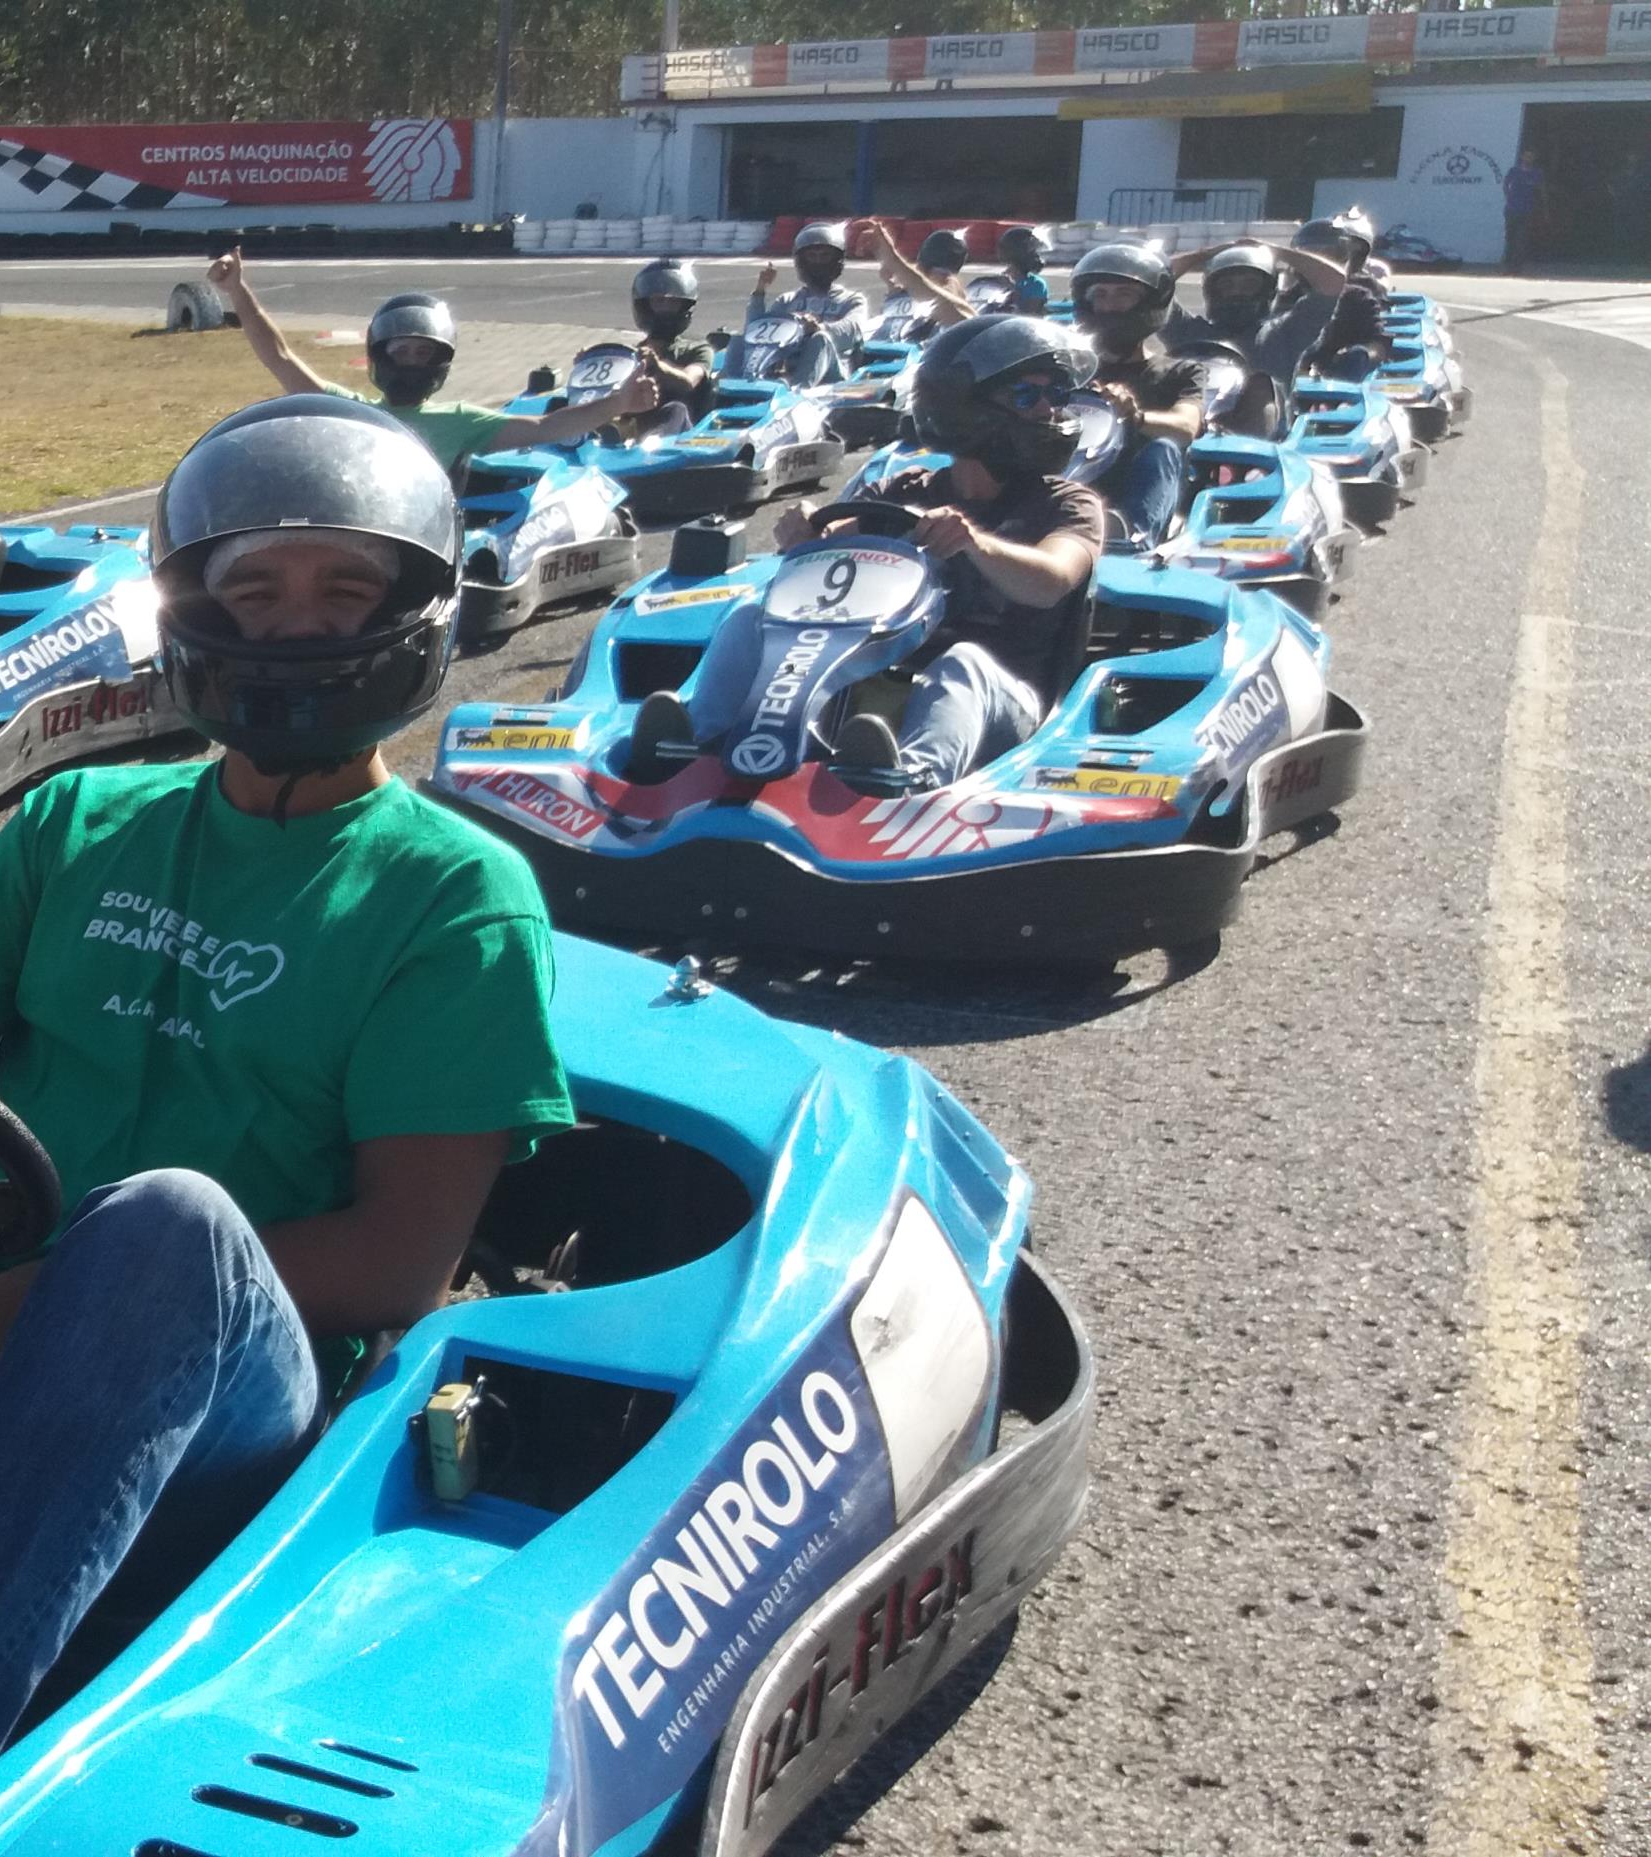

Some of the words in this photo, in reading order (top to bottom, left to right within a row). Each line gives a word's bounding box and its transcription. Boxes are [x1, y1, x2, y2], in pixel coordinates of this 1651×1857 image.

[1245, 24, 1330, 46] HASCO
[1424, 16, 1516, 38] HASCO
[932, 40, 1003, 59] HASCO
[1083, 33, 1160, 52] HASCO
[793, 46, 859, 66] HASCO
[141, 147, 225, 163] CENTROS
[230, 140, 353, 163] MAQUINAÇÃO
[185, 169, 232, 185] ALTA
[236, 167, 348, 183] VELOCIDADE
[754, 321, 780, 340] 27
[580, 360, 614, 382] 28
[816, 557, 857, 608] 9
[503, 733, 572, 749] eni
[1089, 775, 1170, 798] eni
[496, 773, 595, 832] HURON
[100, 891, 153, 912] SOU
[572, 1371, 857, 1749] TECNIROLO
[656, 1633, 750, 1754] ENGENHARIA
[747, 1533, 831, 1636] INDUSTRIAL,
